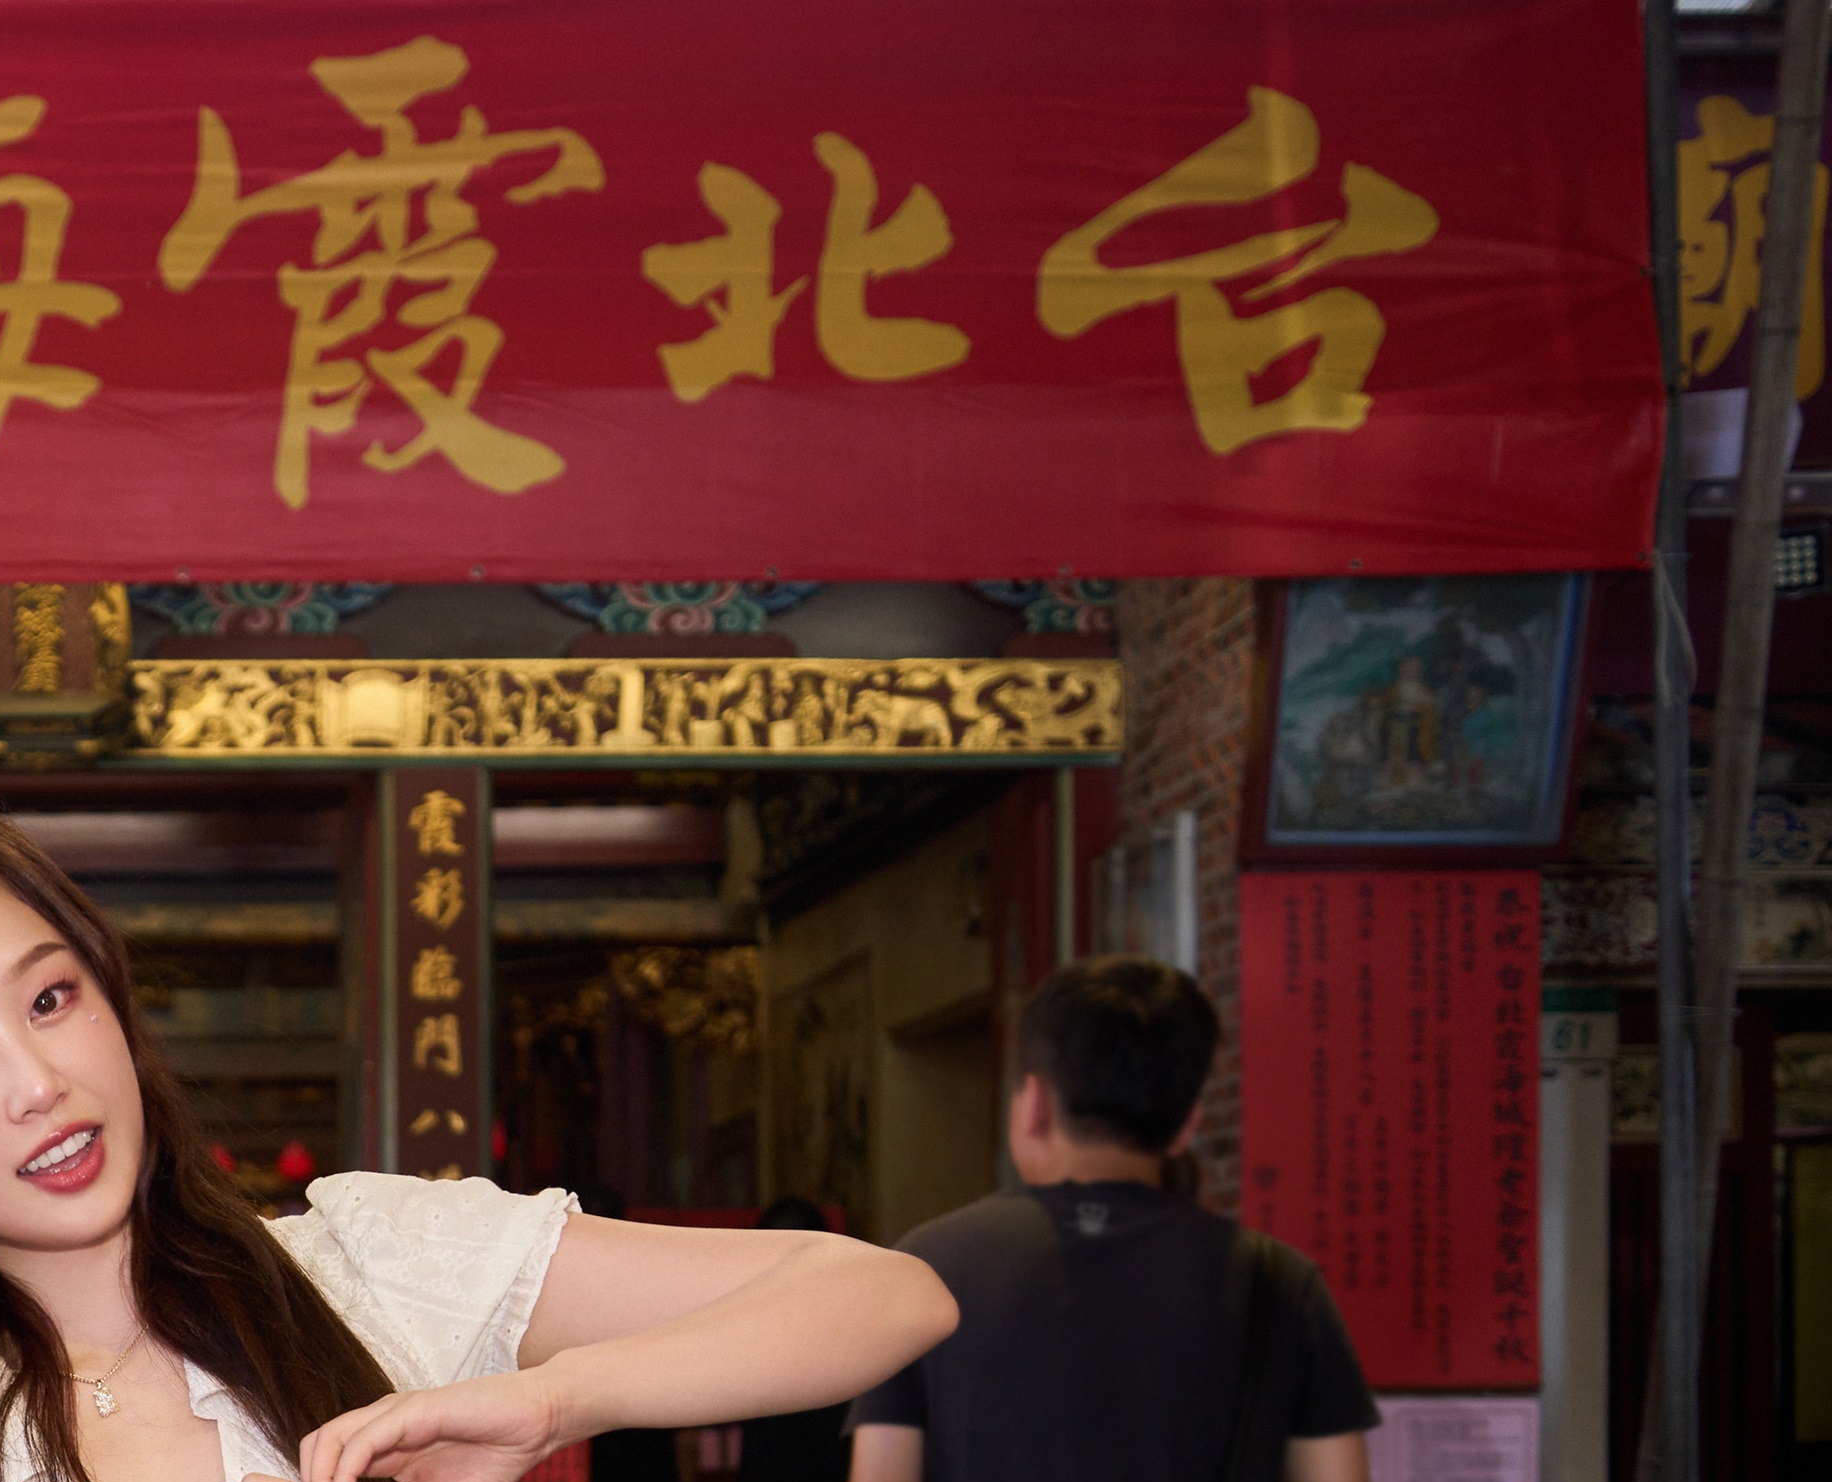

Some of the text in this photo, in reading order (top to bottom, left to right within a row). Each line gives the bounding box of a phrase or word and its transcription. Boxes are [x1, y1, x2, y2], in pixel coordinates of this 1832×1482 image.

[408, 789, 467, 1181] 霞彩臨門八
